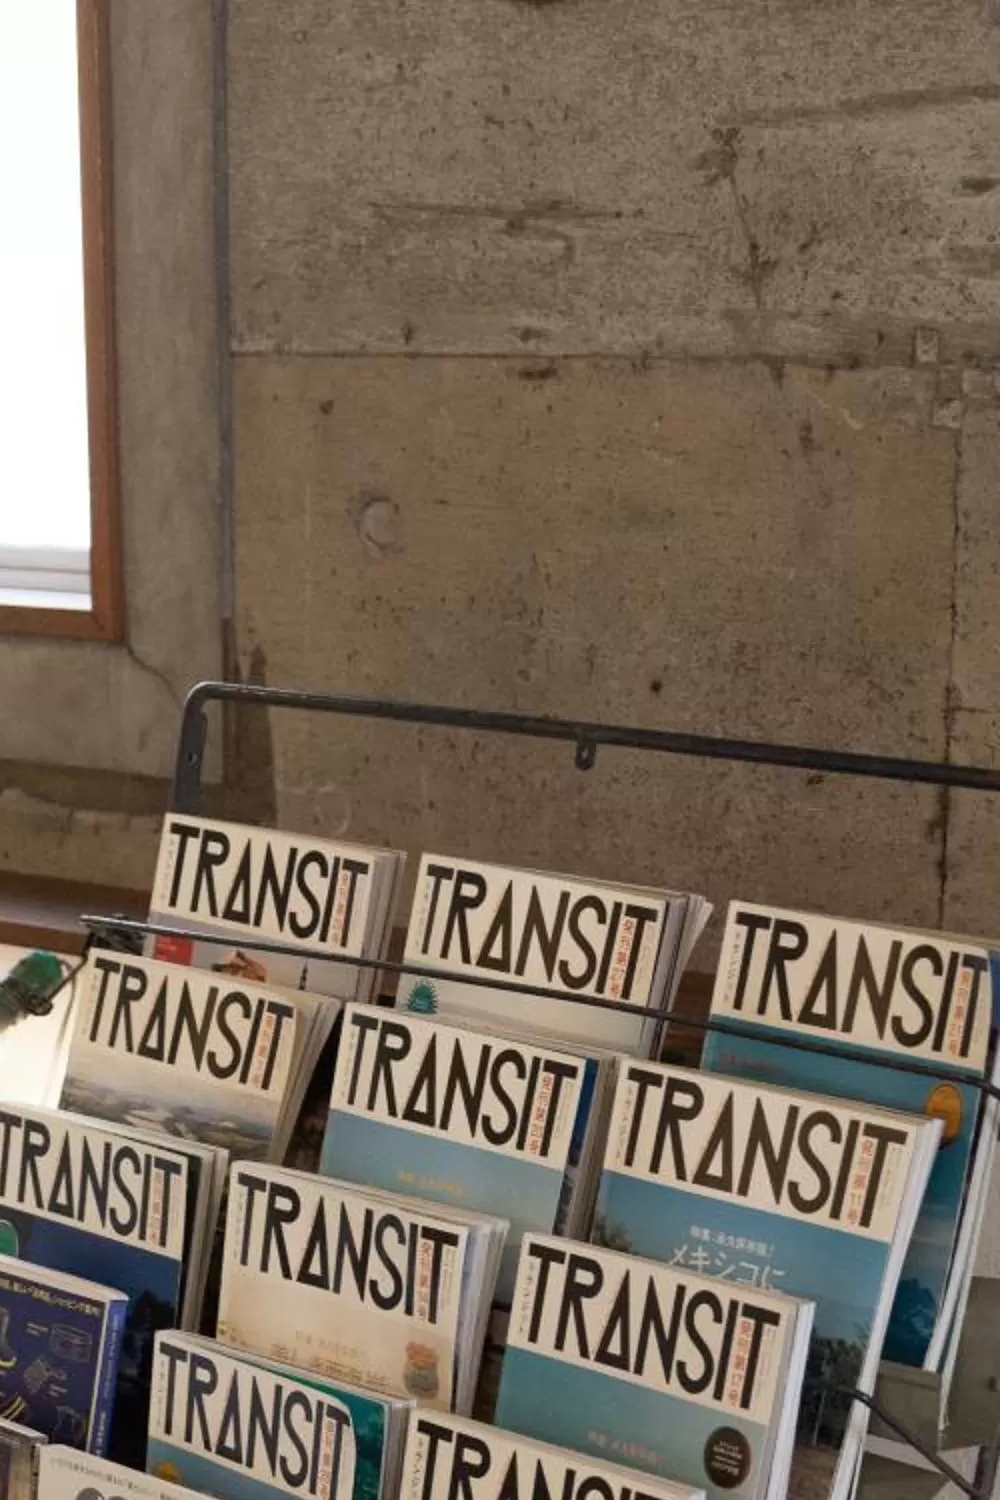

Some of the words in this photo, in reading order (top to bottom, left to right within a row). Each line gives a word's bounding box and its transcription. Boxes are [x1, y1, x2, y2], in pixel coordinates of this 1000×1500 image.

[170, 822, 368, 949] TRANSIT
[426, 863, 658, 999] TRANSIT
[90, 959, 295, 1090] TRANSIT
[733, 912, 987, 1058] TRANSIT
[348, 1013, 577, 1157] TRANSIT
[624, 1067, 907, 1228] TRANSIT
[237, 1173, 459, 1324] TRANSIT
[528, 1243, 780, 1409] TRANSIT
